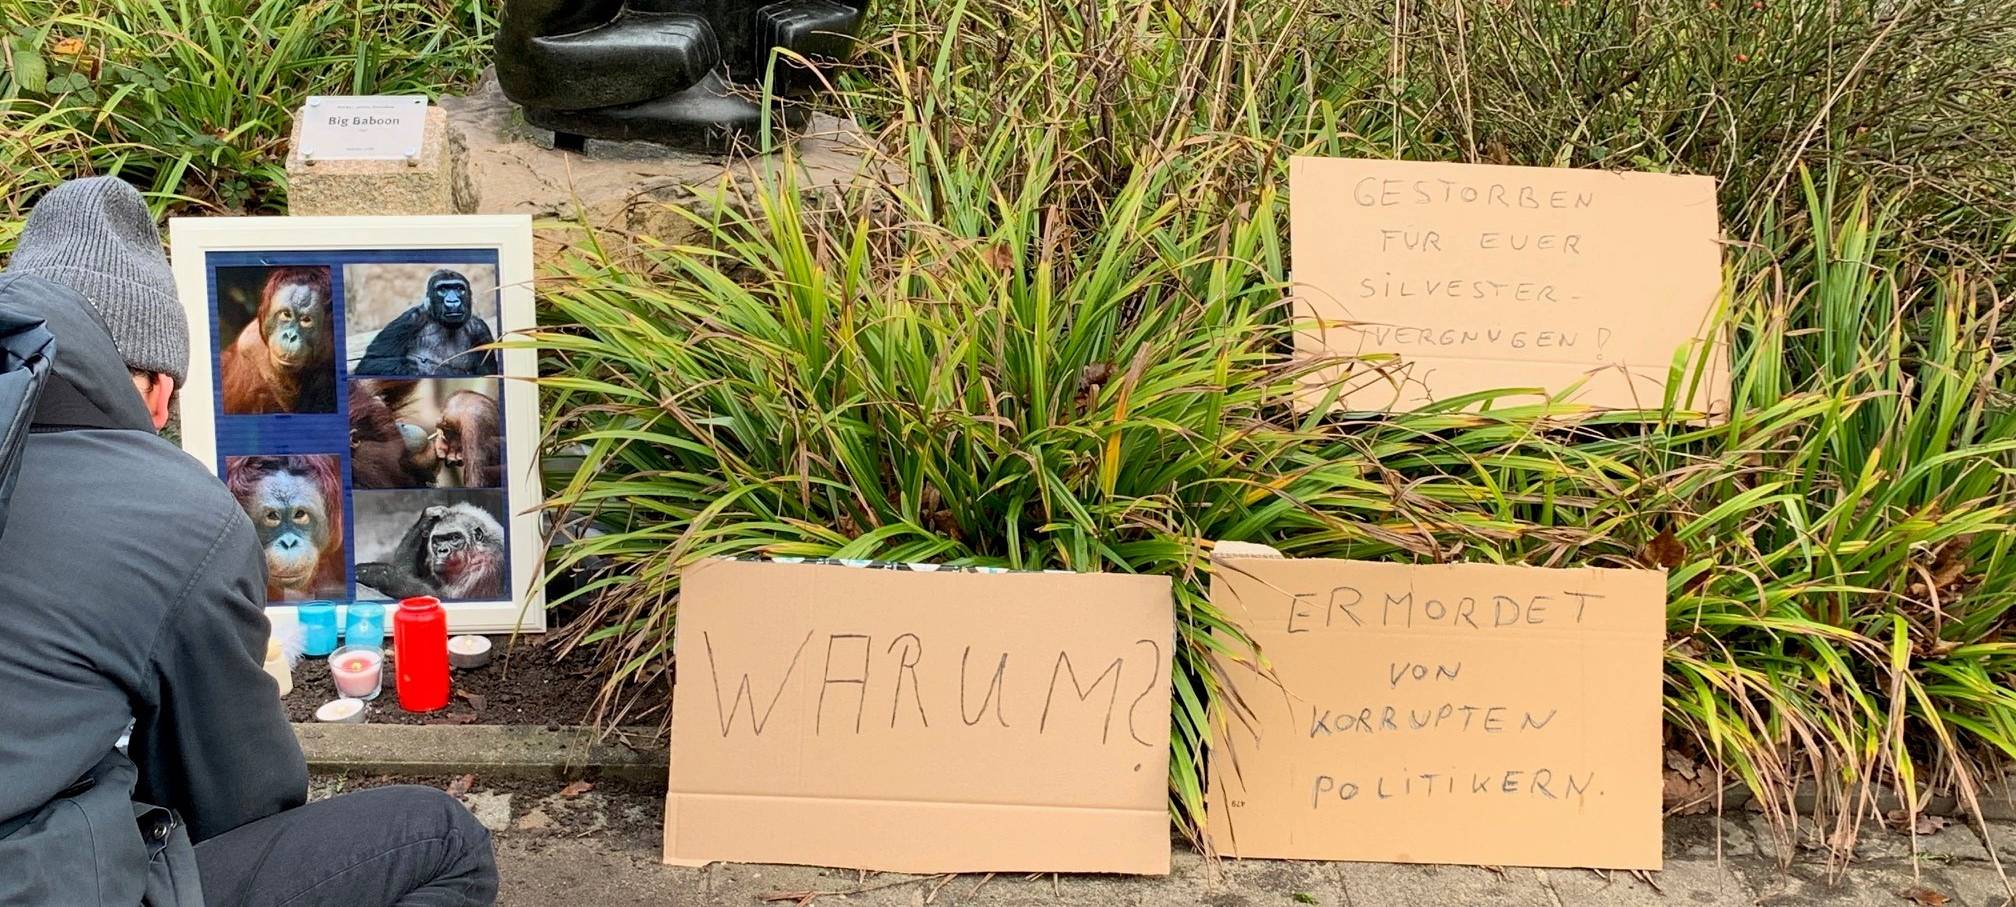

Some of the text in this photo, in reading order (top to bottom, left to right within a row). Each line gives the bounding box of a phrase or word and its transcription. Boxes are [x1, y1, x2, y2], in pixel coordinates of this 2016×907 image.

[328, 116, 400, 128] Big Baboon
[1353, 176, 1594, 210] GESTORBEN
[1479, 232, 1582, 254] EUER
[1286, 586, 1606, 634] ERMORDET
[1390, 661, 1462, 689] VON
[703, 629, 1161, 773] WARUM?
[1309, 703, 1558, 739] KORRUPTEN
